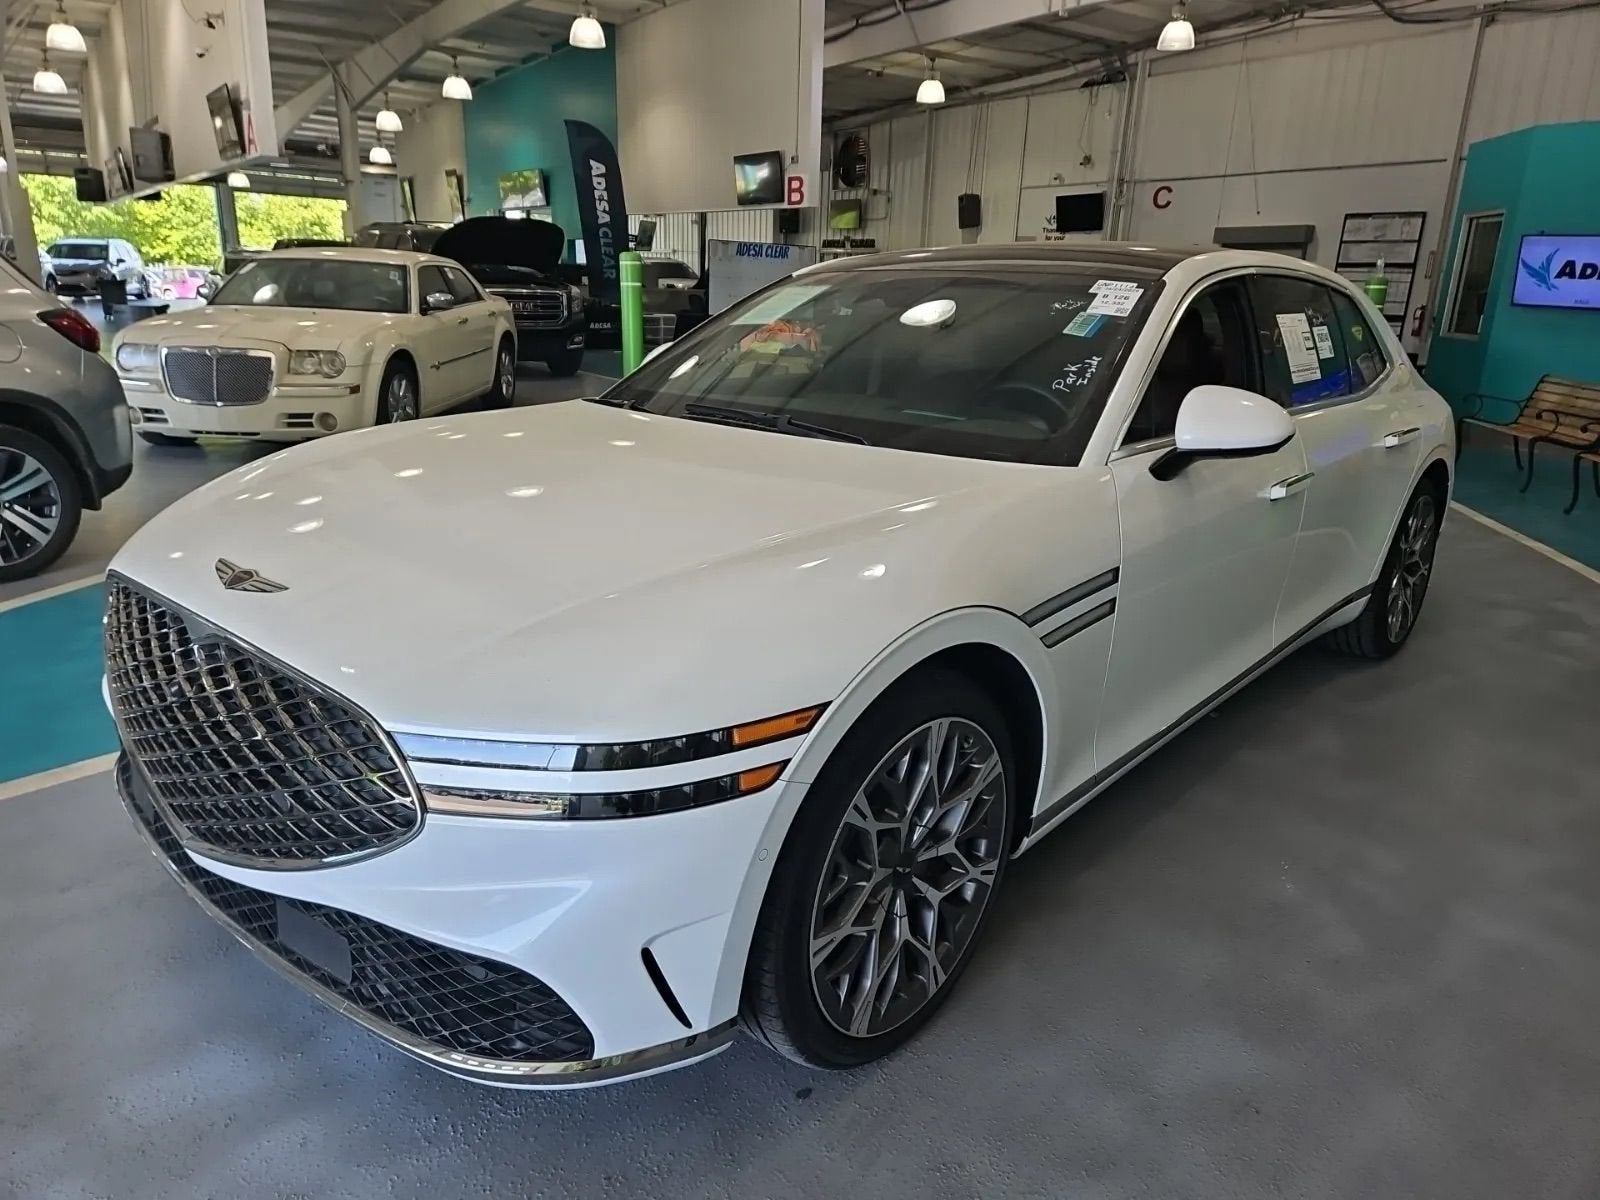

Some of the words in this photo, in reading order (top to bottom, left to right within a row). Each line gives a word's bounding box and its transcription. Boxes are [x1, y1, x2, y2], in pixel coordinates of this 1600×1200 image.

[247, 113, 258, 155] A
[589, 159, 611, 225] ADESA
[787, 175, 805, 206] B
[1152, 186, 1173, 209] C
[599, 227, 616, 279] CLEAR
[736, 242, 763, 258] ADESA
[765, 245, 791, 260] CLEAR
[1553, 259, 1600, 280] AD
[1052, 363, 1083, 393] Park
[1076, 355, 1104, 386] Inside
